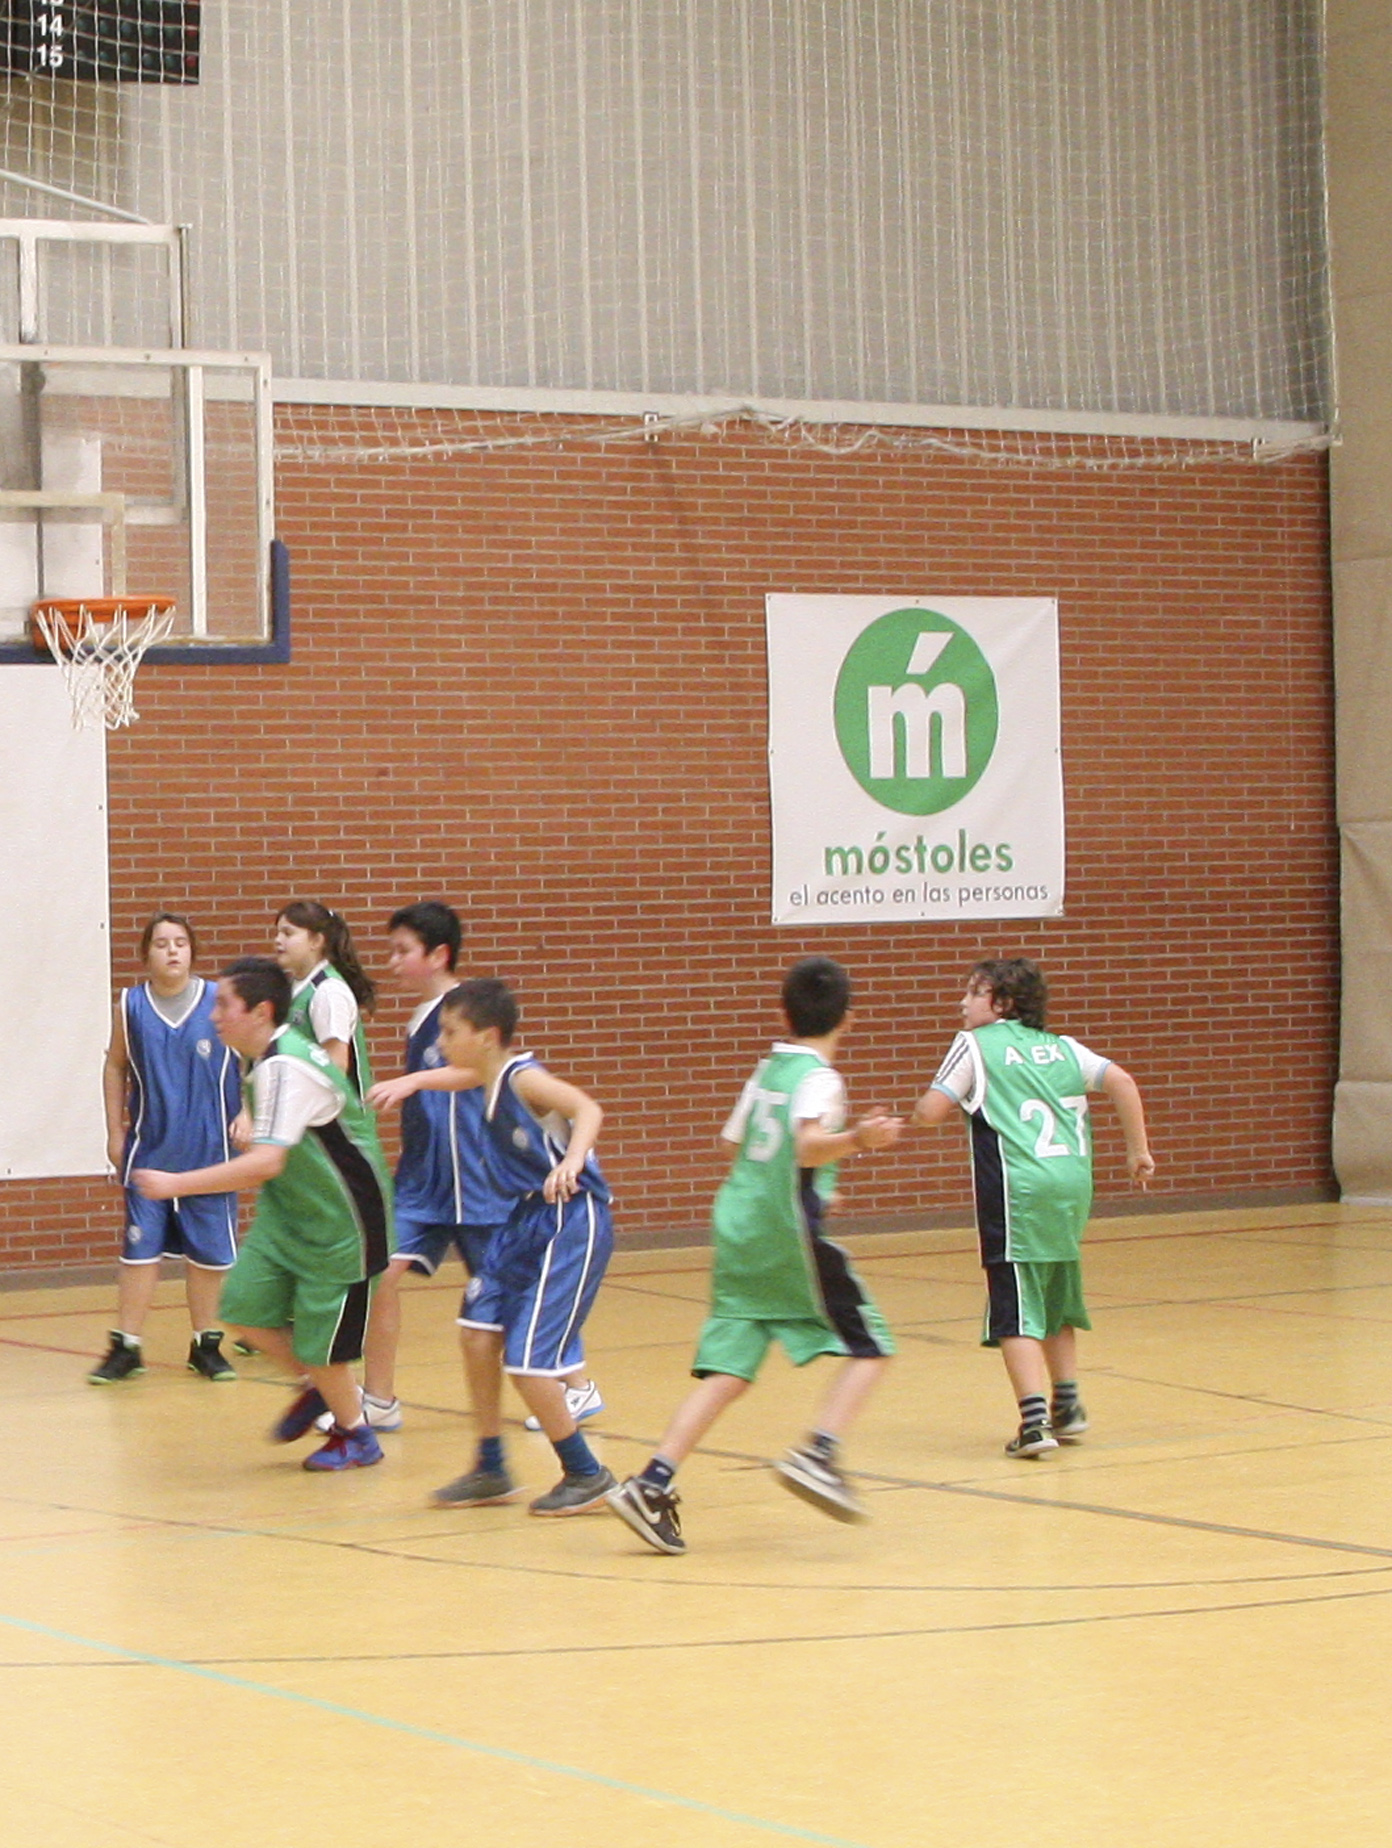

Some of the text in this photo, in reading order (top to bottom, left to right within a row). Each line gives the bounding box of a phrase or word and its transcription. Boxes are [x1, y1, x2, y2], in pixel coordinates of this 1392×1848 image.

[36, 13, 64, 37] 14
[36, 43, 64, 68] 15
[824, 828, 1014, 876] móstoles
[789, 881, 1049, 907] el acento en las personas
[1004, 1043, 1066, 1066] AEX
[1019, 1094, 1088, 1159] 27
